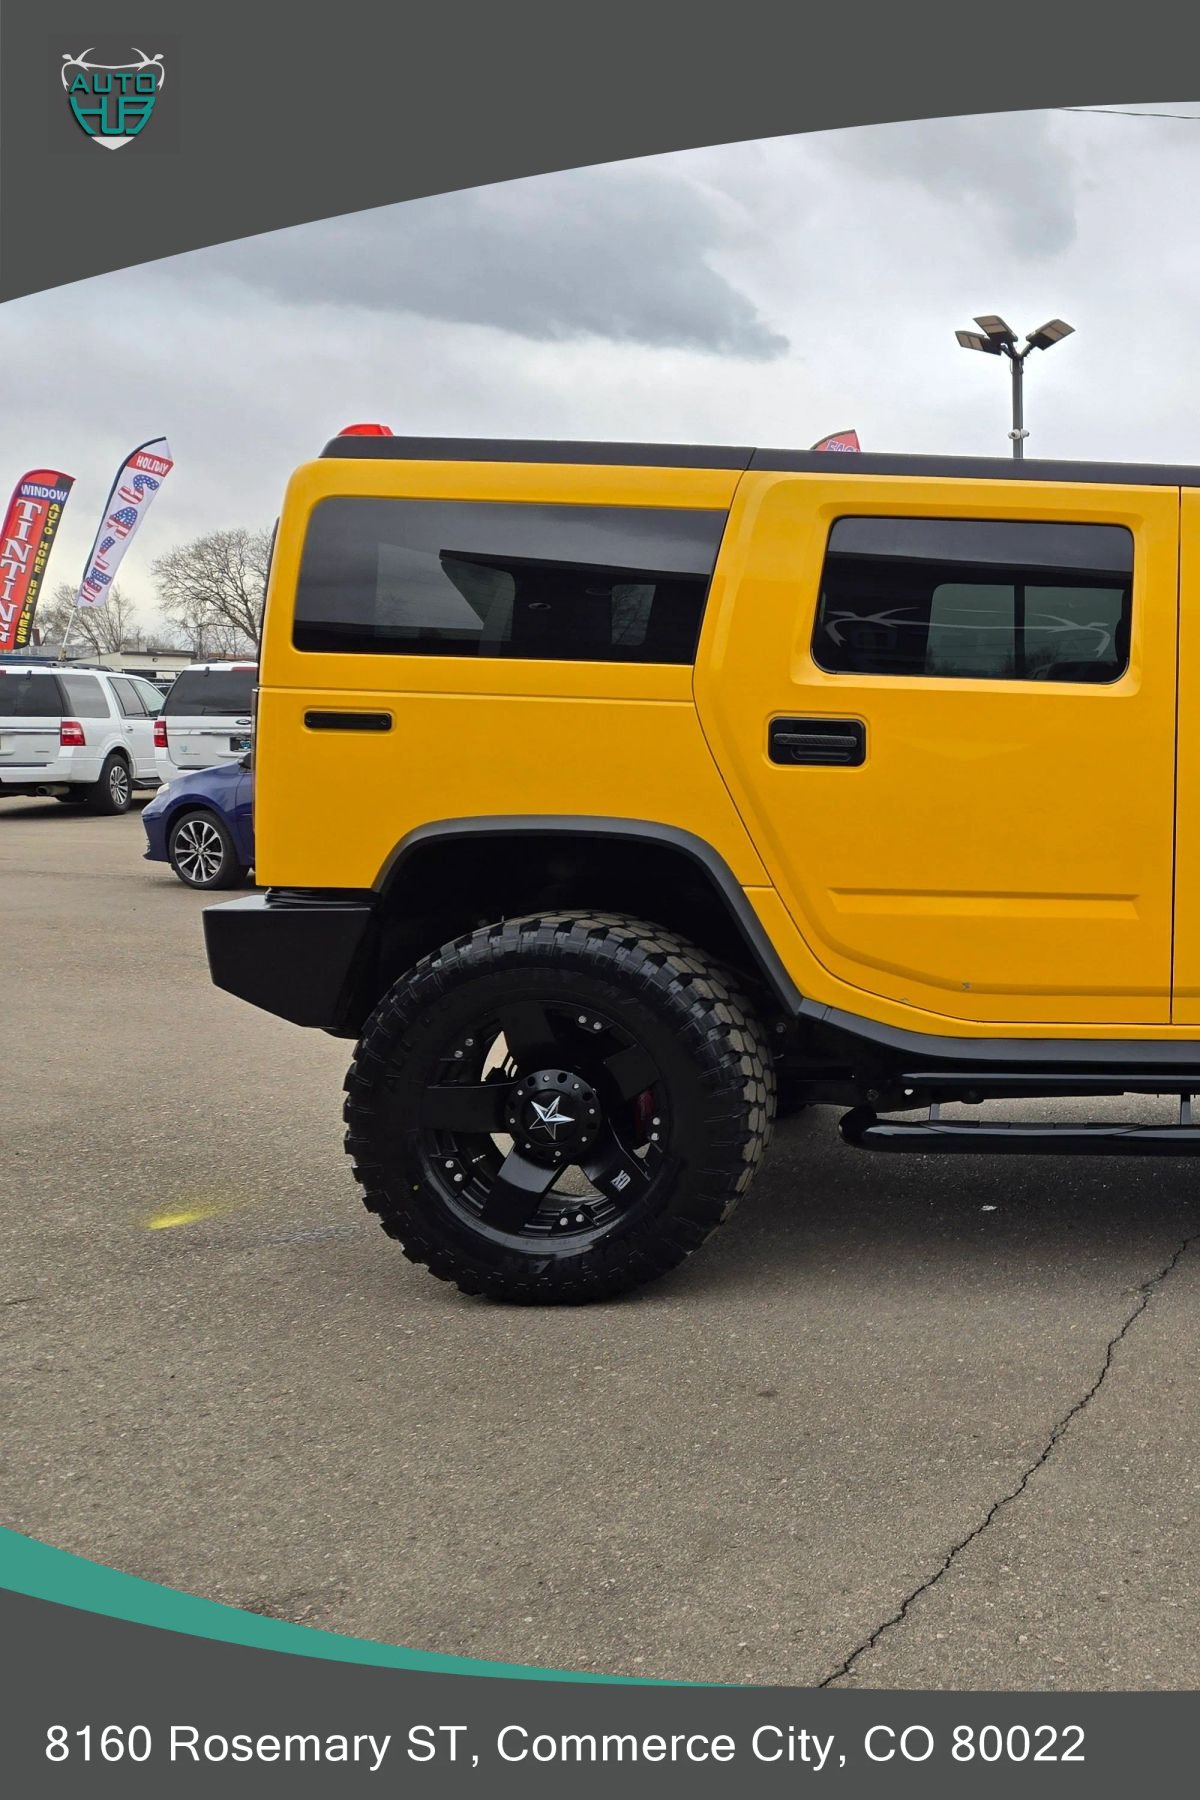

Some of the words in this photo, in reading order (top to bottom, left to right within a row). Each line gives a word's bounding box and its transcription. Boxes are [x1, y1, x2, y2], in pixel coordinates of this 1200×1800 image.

[136, 455, 169, 476] HOLIDAY
[21, 484, 68, 502] WINDOW
[44, 503, 61, 536] AUTO
[80, 473, 160, 604] SALE
[34, 541, 49, 574] HOME
[16, 579, 38, 644] BUSINESS
